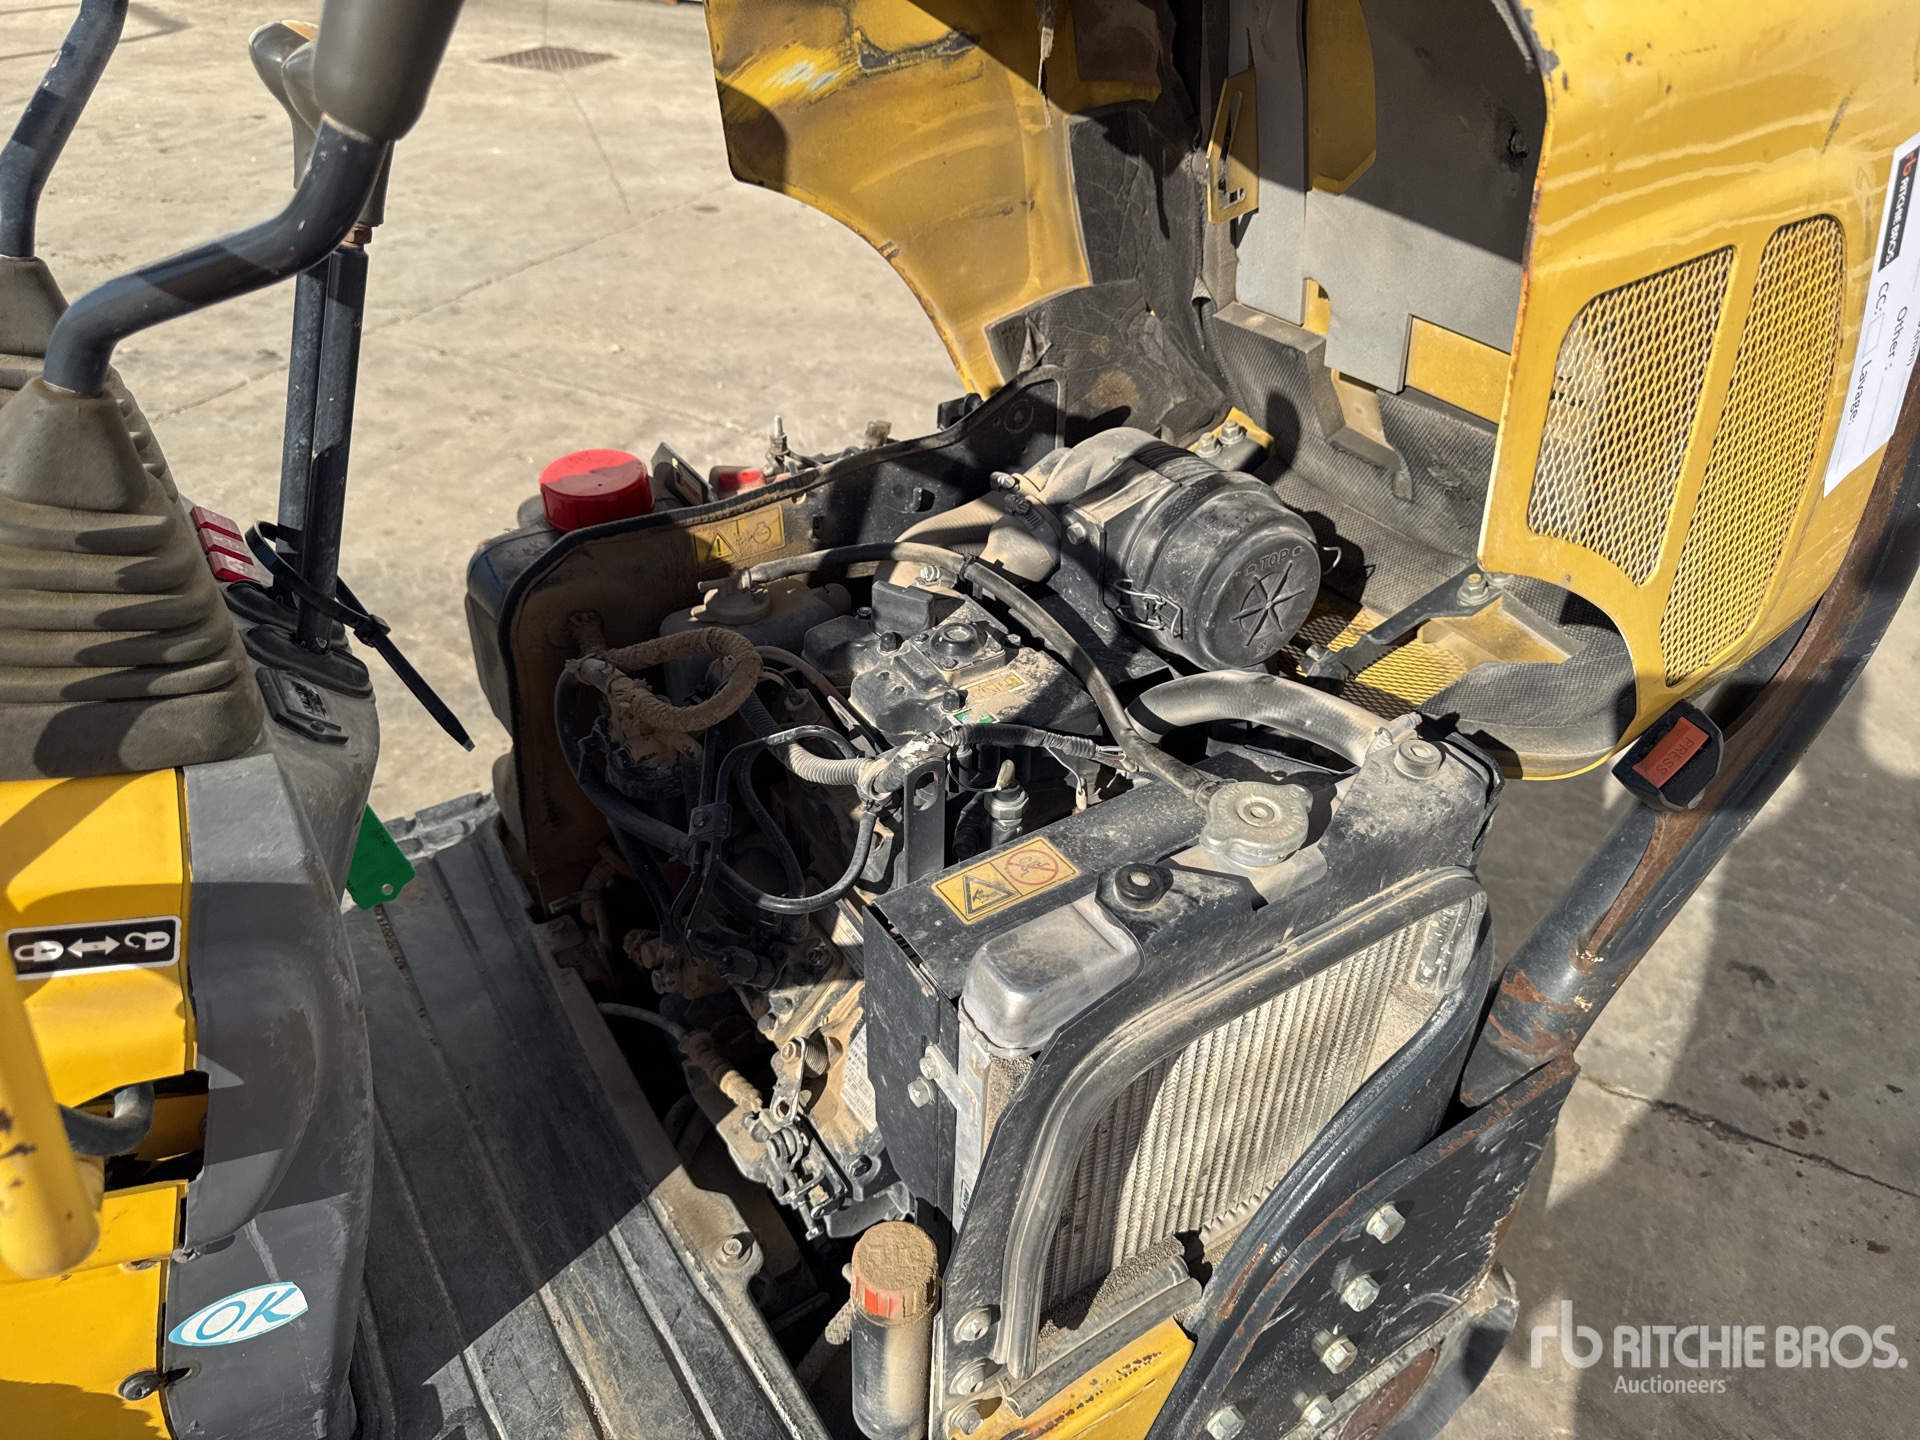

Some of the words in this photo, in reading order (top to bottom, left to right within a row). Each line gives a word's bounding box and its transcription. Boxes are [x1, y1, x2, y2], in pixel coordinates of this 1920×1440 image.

[1892, 176, 1909, 226] RITCHIE
[1874, 281, 1890, 315] CC:
[1848, 359, 1872, 425] Lavage:
[1260, 548, 1289, 570] TOP
[1655, 737, 1695, 775] PRESS
[195, 1287, 298, 1340] OK
